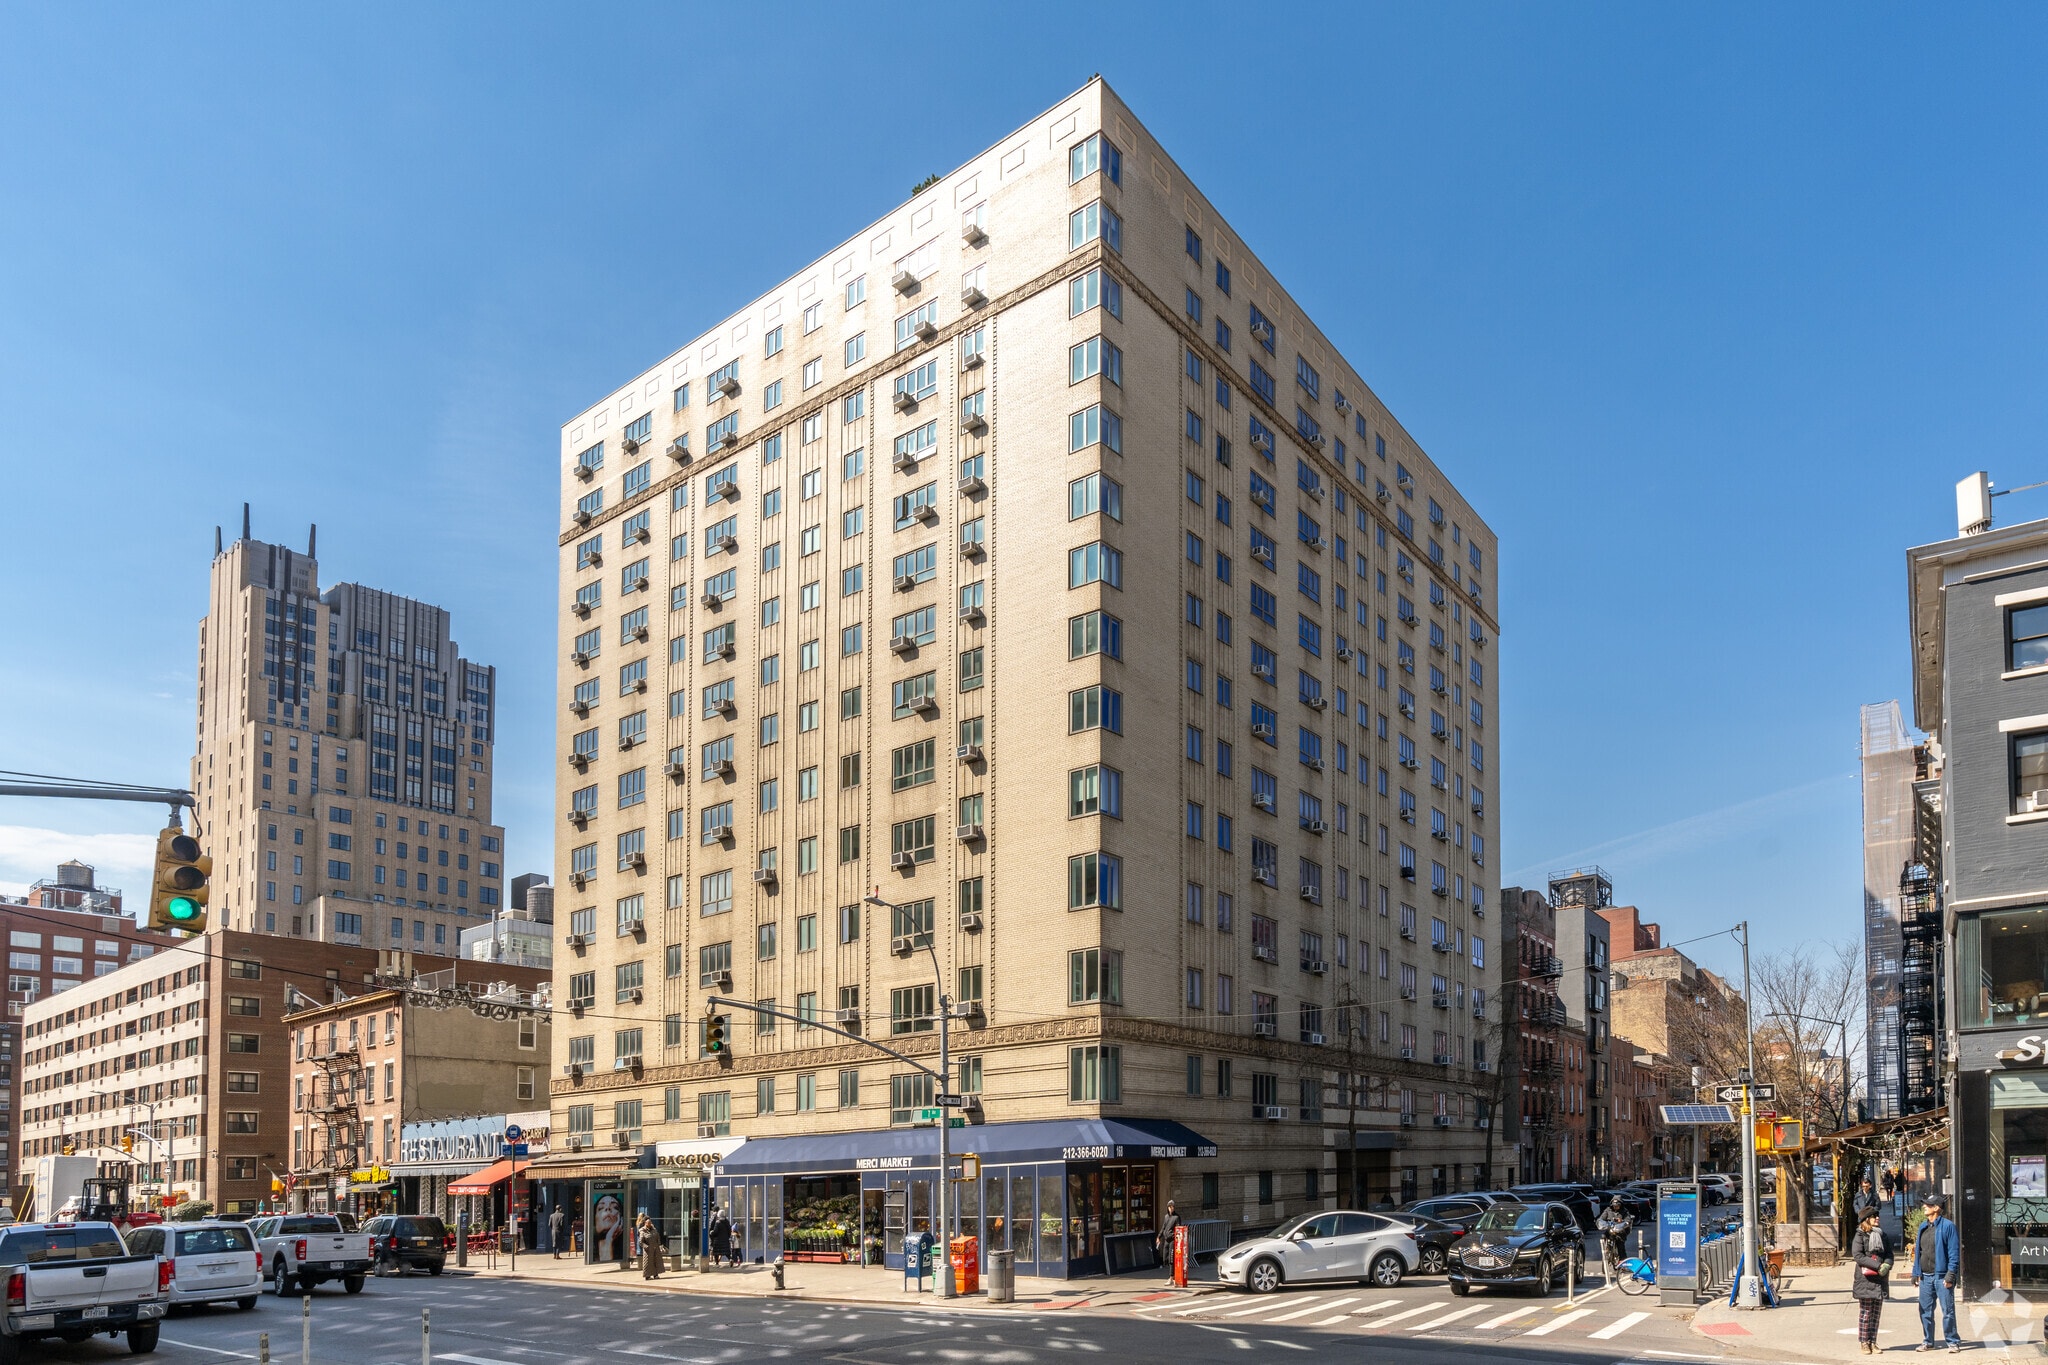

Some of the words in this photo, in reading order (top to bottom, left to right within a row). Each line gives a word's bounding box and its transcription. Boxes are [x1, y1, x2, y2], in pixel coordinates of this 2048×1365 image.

[400, 1132, 501, 1162] RESTAURANT
[1063, 1146, 1109, 1159] 212-366-6020
[1151, 1146, 1166, 1157] MERCI
[1166, 1146, 1187, 1157] MARKET
[657, 1153, 721, 1166] BAGGIOS
[856, 1158, 879, 1169] MERCI
[880, 1157, 913, 1168] MARKET
[2020, 1245, 2040, 1257] Art
